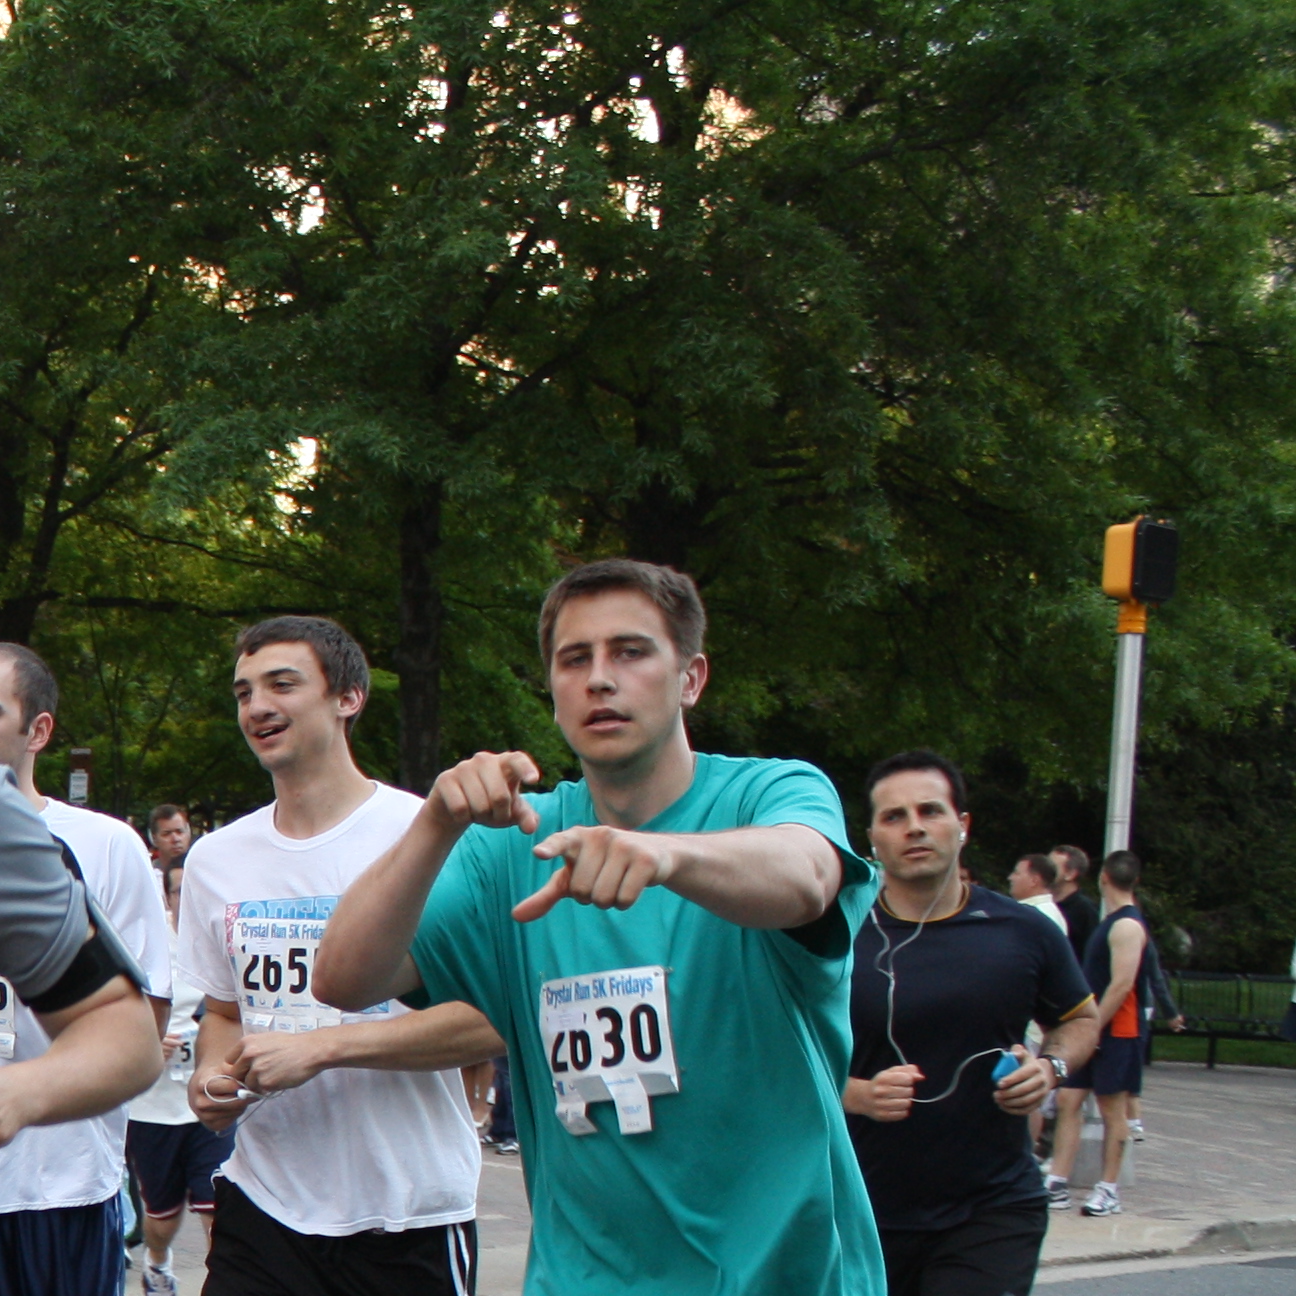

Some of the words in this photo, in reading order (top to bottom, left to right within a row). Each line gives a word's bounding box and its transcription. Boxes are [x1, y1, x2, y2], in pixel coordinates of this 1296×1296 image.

[240, 922, 269, 940] Crystal
[271, 923, 287, 939] Run
[288, 923, 301, 939] 5K
[240, 944, 320, 994] 265
[574, 981, 590, 1000] Run
[592, 978, 606, 999] 5K
[608, 974, 654, 999] Fridays
[550, 1003, 662, 1074] 2630
